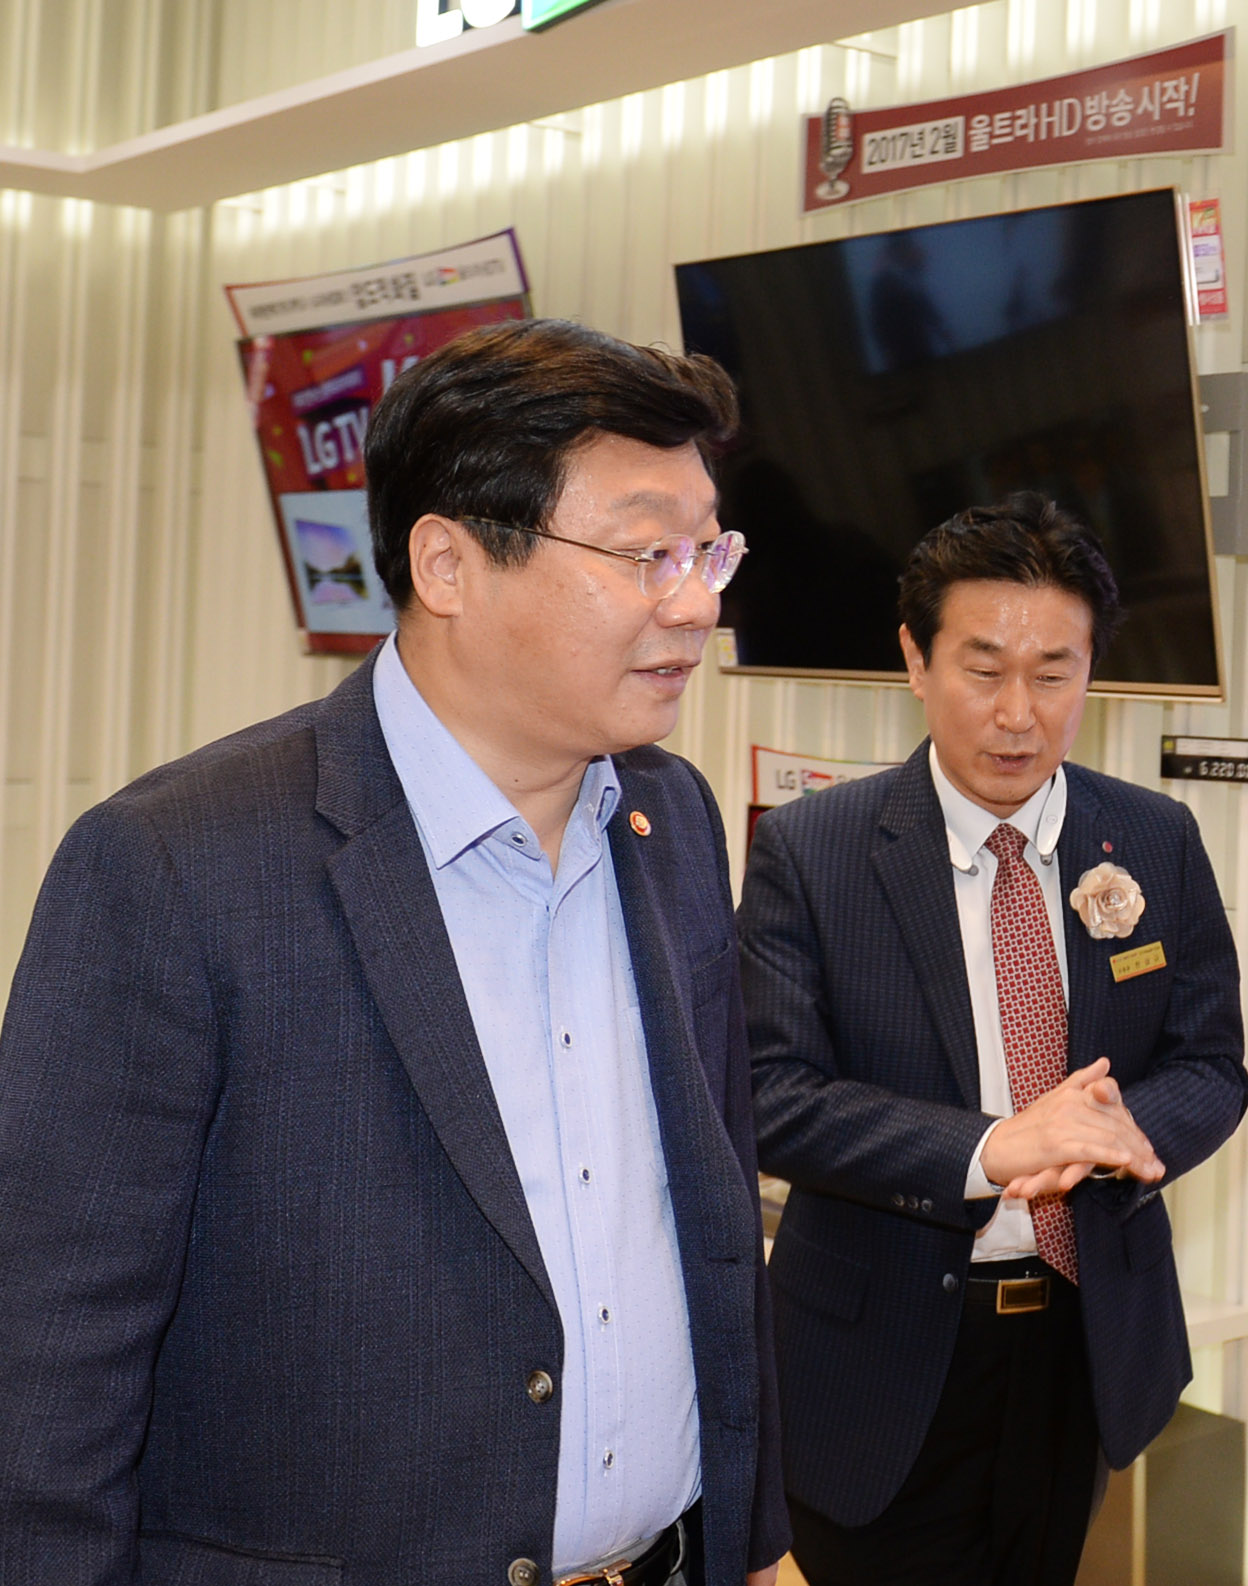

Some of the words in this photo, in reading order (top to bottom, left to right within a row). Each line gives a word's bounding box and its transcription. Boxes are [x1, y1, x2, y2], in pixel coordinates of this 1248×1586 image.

[867, 132, 925, 167] 2017년
[931, 124, 960, 156] 2월
[1085, 88, 1135, 132] 방송
[1137, 72, 1200, 121] 시작!
[297, 421, 338, 475] LG
[776, 768, 796, 790] LG
